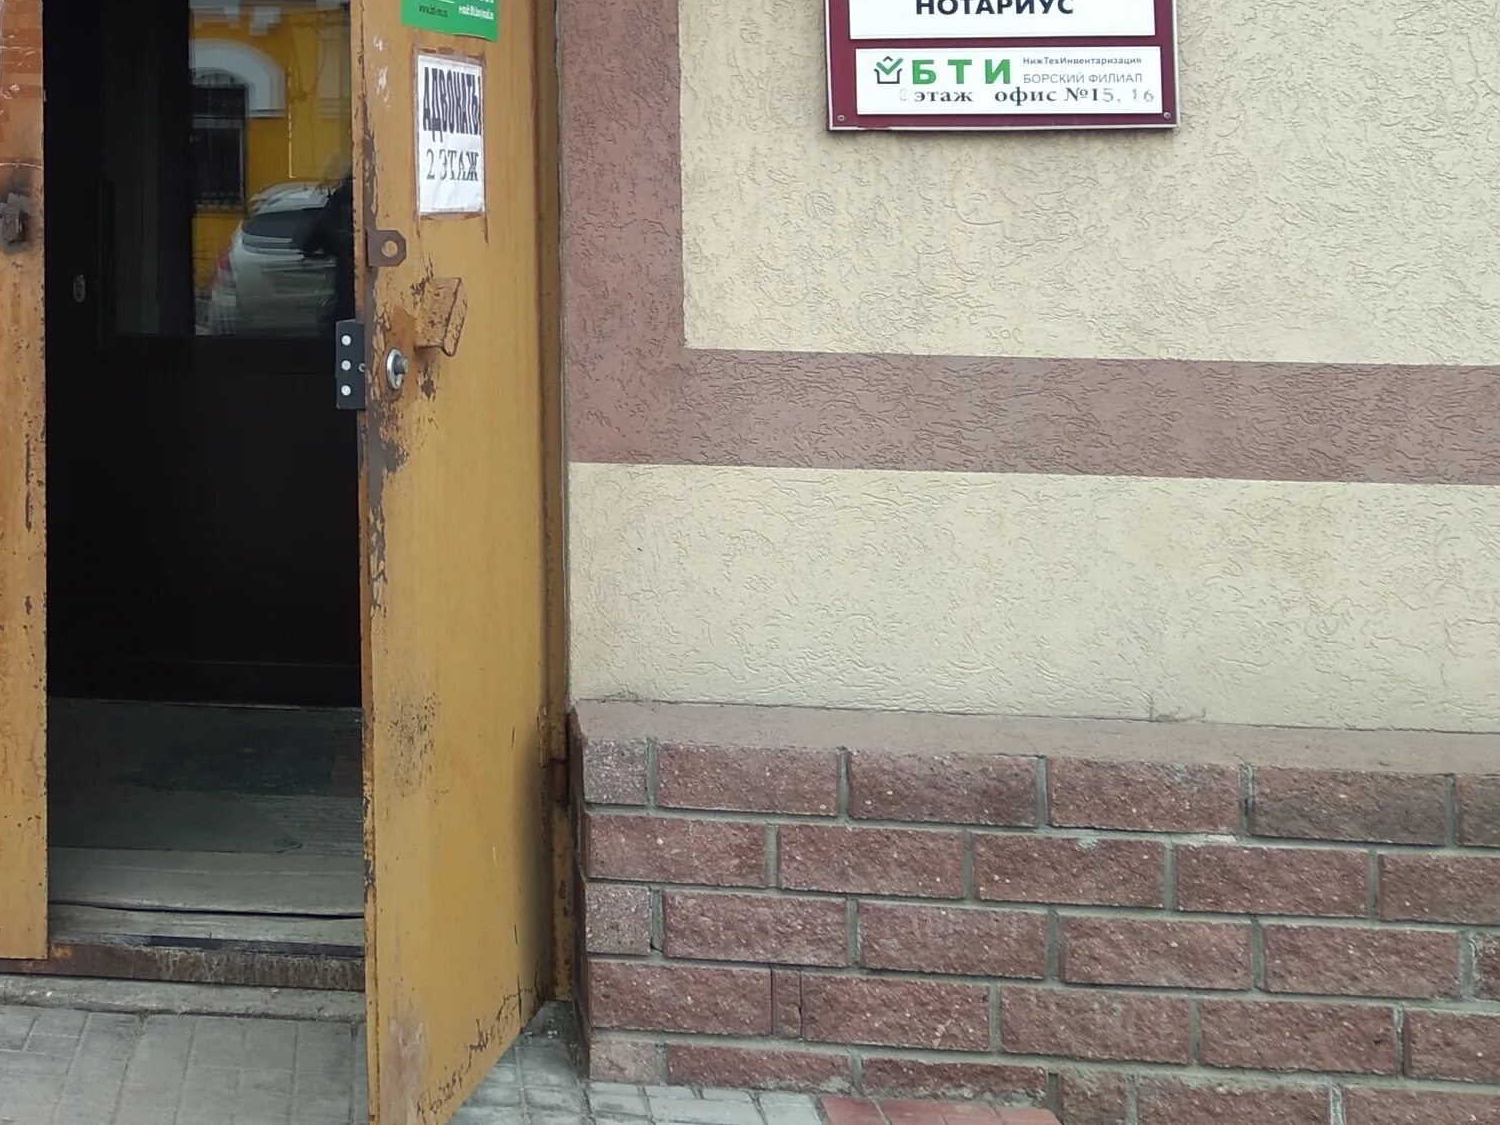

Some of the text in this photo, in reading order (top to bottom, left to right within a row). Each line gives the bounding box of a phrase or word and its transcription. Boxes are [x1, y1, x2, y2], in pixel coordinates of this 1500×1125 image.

[912, 59, 1011, 84] БТИ
[1023, 56, 1142, 66] НижТехИнвентаризация
[1023, 72, 1143, 84] БОРСКИЙ ФИЛИАЛ
[423, 66, 482, 142] АДВОКАТЫ
[914, 90, 974, 102] этаж
[994, 87, 1057, 106] офис
[426, 148, 479, 182] 2 ЭТАЖ
